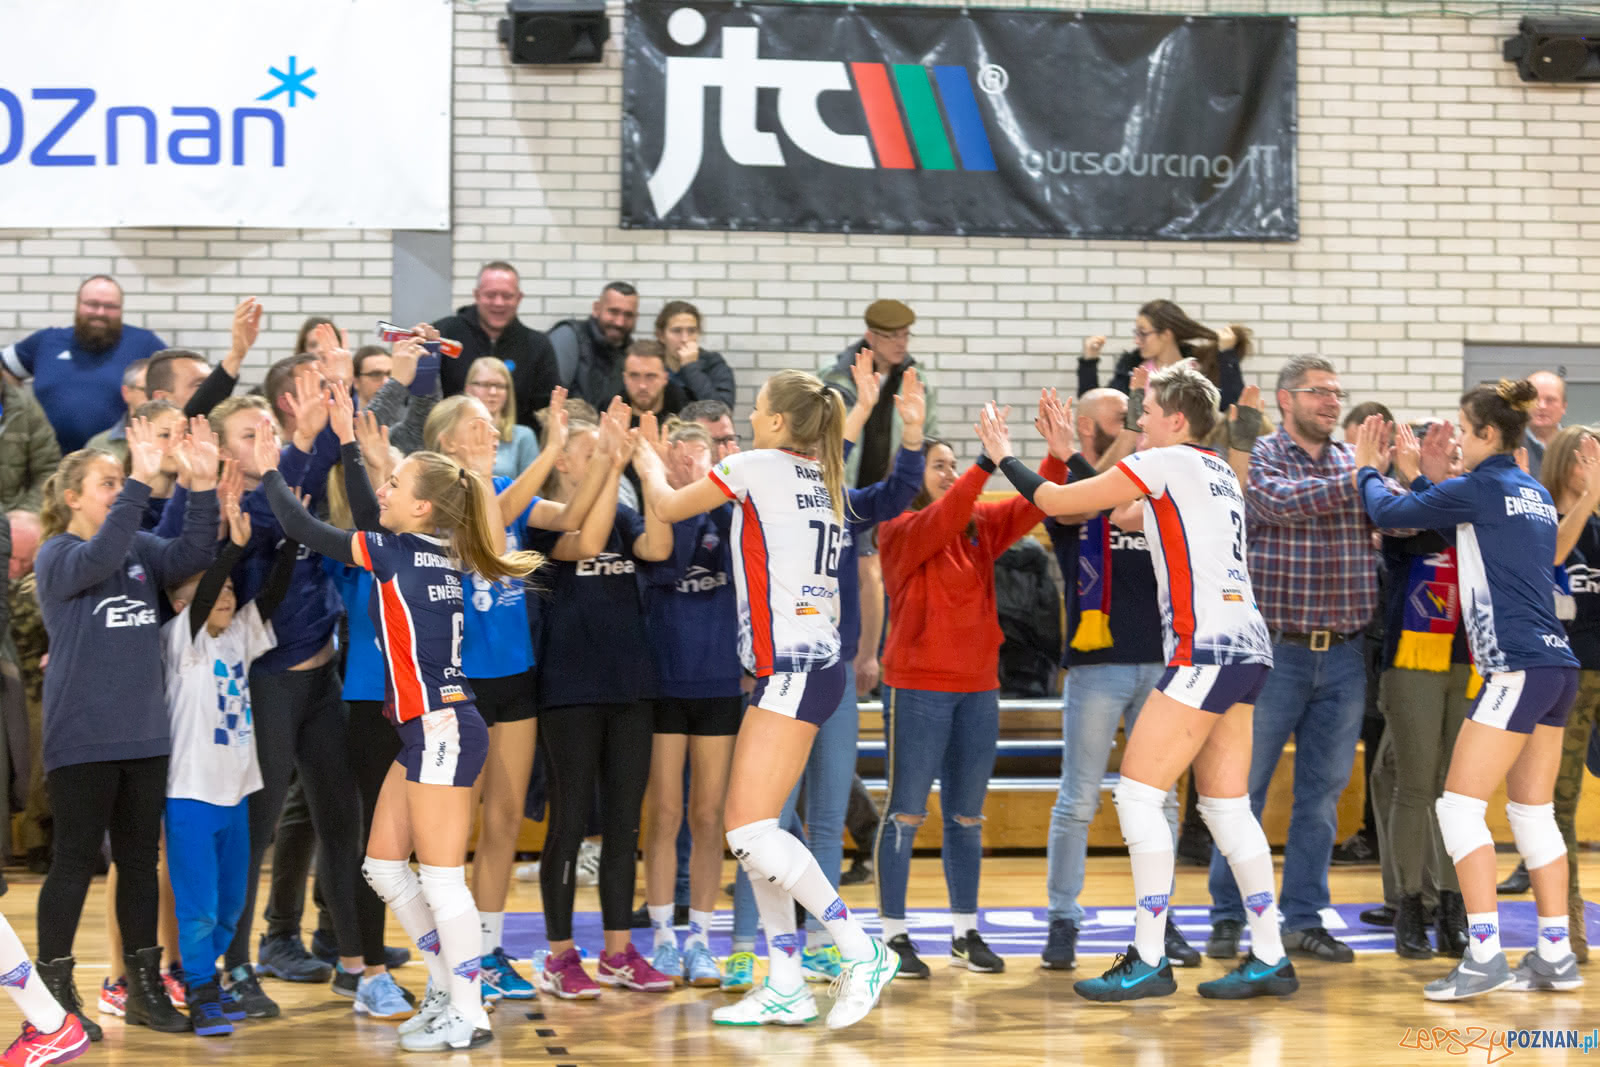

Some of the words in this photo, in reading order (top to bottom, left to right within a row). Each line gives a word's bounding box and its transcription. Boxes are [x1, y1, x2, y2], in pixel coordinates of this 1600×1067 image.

[647, 7, 876, 220] jtc
[1021, 149, 1235, 188] outsourcing
[1248, 145, 1279, 177] IT
[575, 557, 635, 577] Enea
[808, 519, 843, 578] 16
